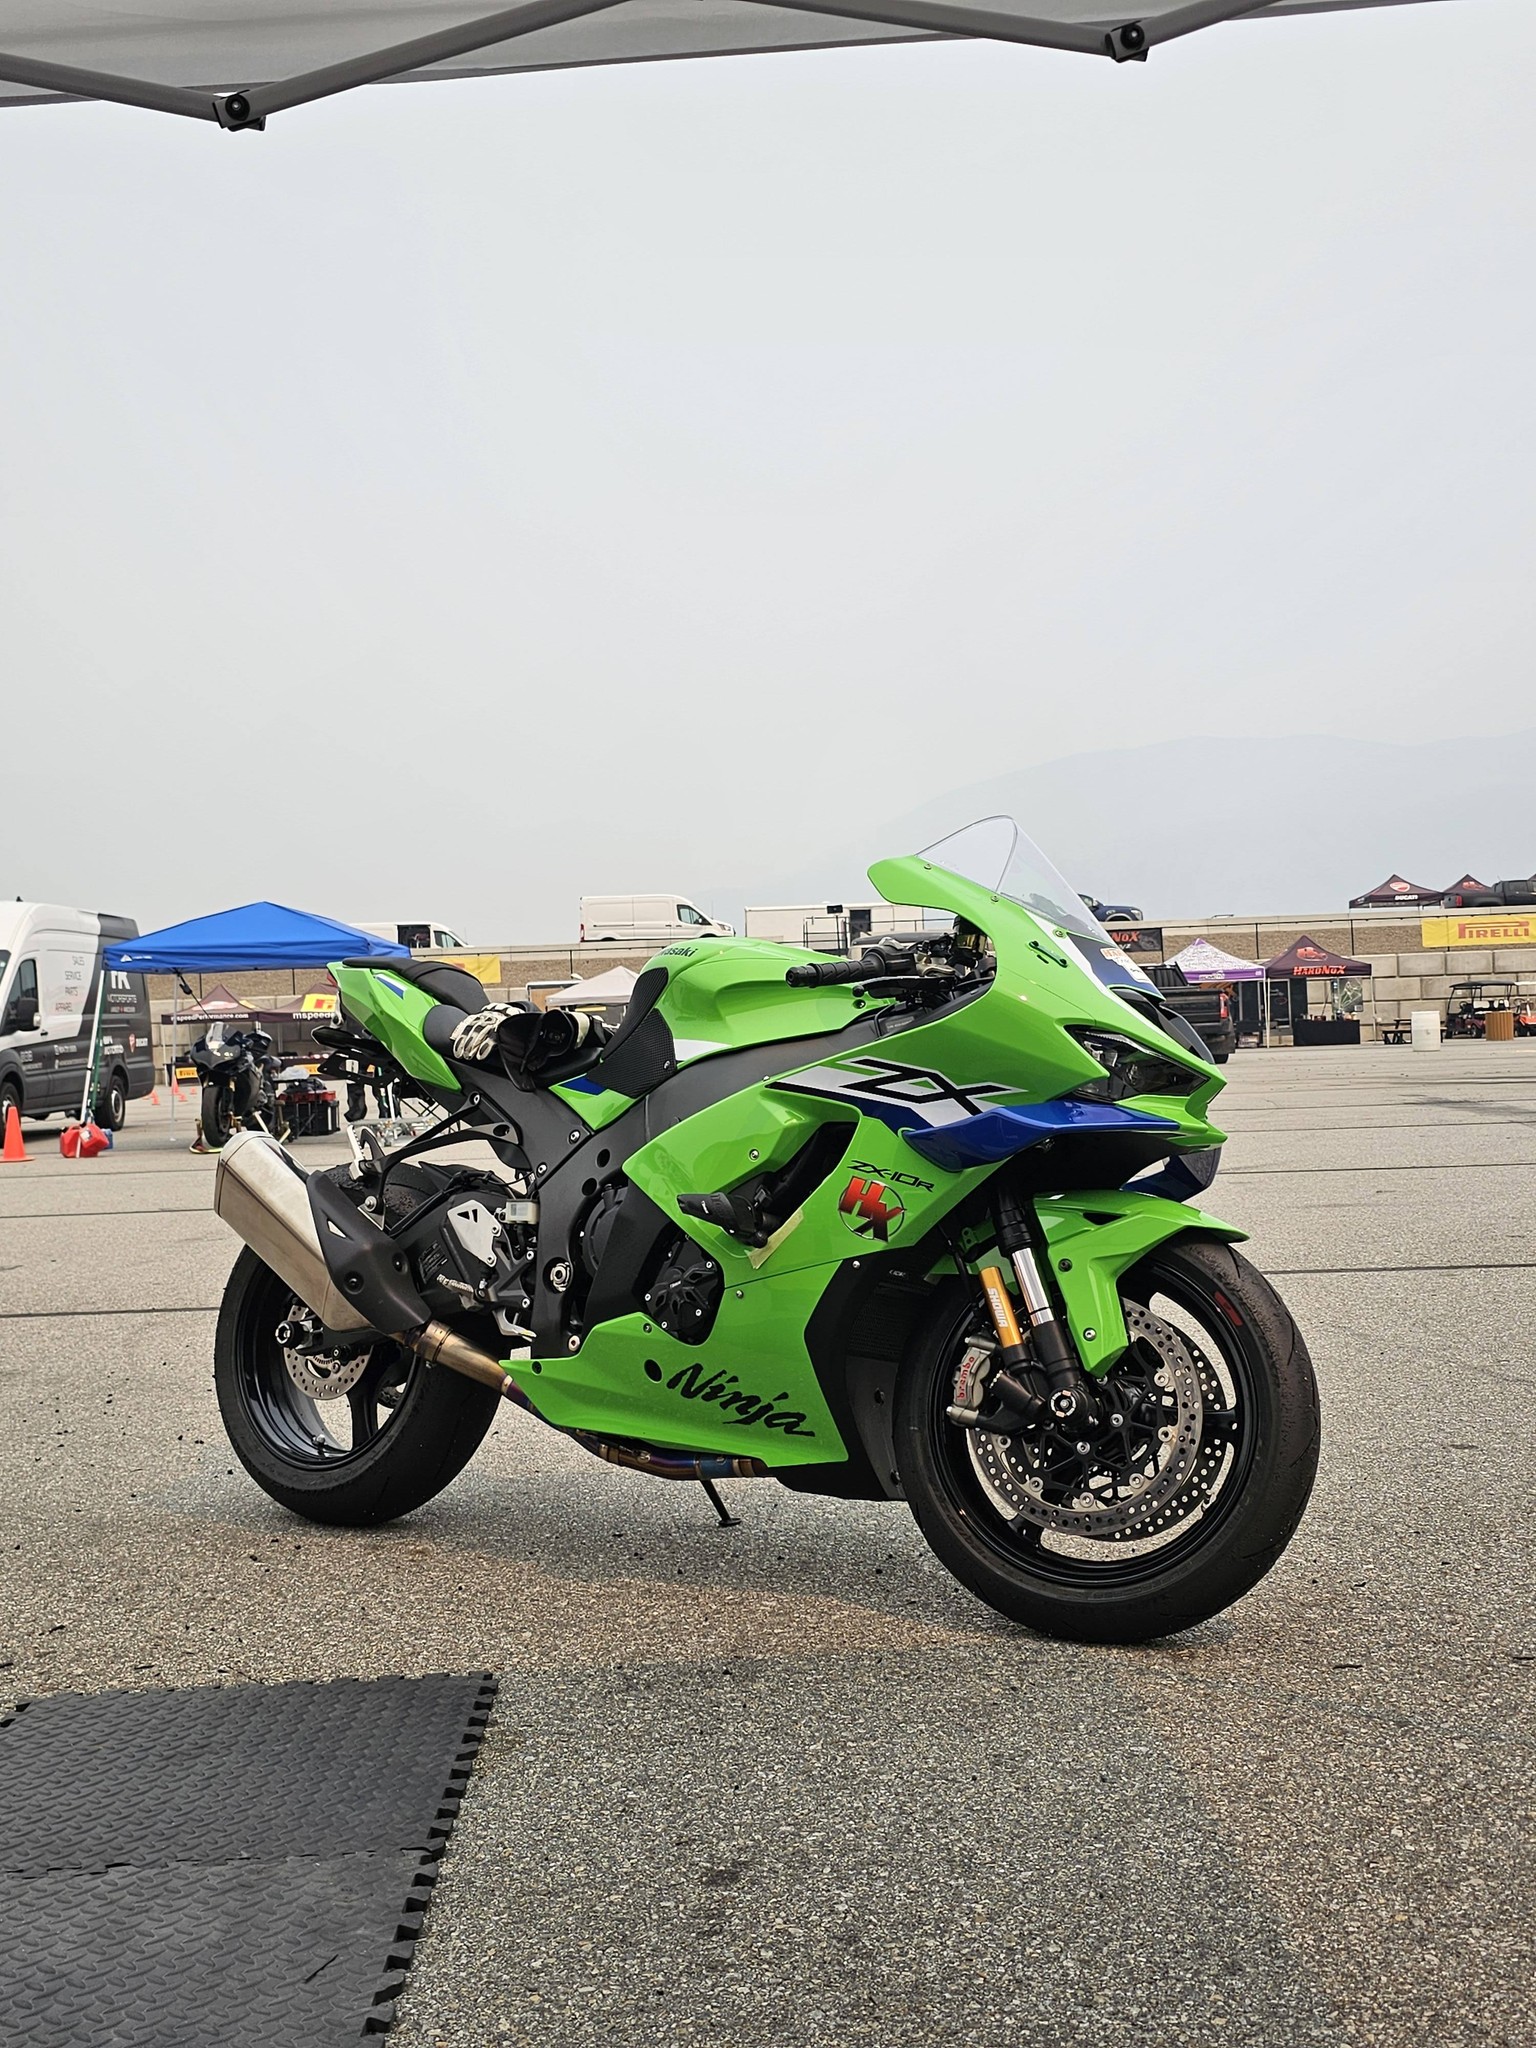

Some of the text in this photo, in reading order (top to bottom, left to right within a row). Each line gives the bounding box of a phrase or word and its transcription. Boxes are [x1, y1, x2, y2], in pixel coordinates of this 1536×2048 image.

[1457, 920, 1530, 940] PIRELLI
[847, 1160, 935, 1192] ZX-10R
[987, 1287, 1008, 1328] SHOWA
[956, 1356, 975, 1399] brembo
[666, 1362, 816, 1437] Ninja
